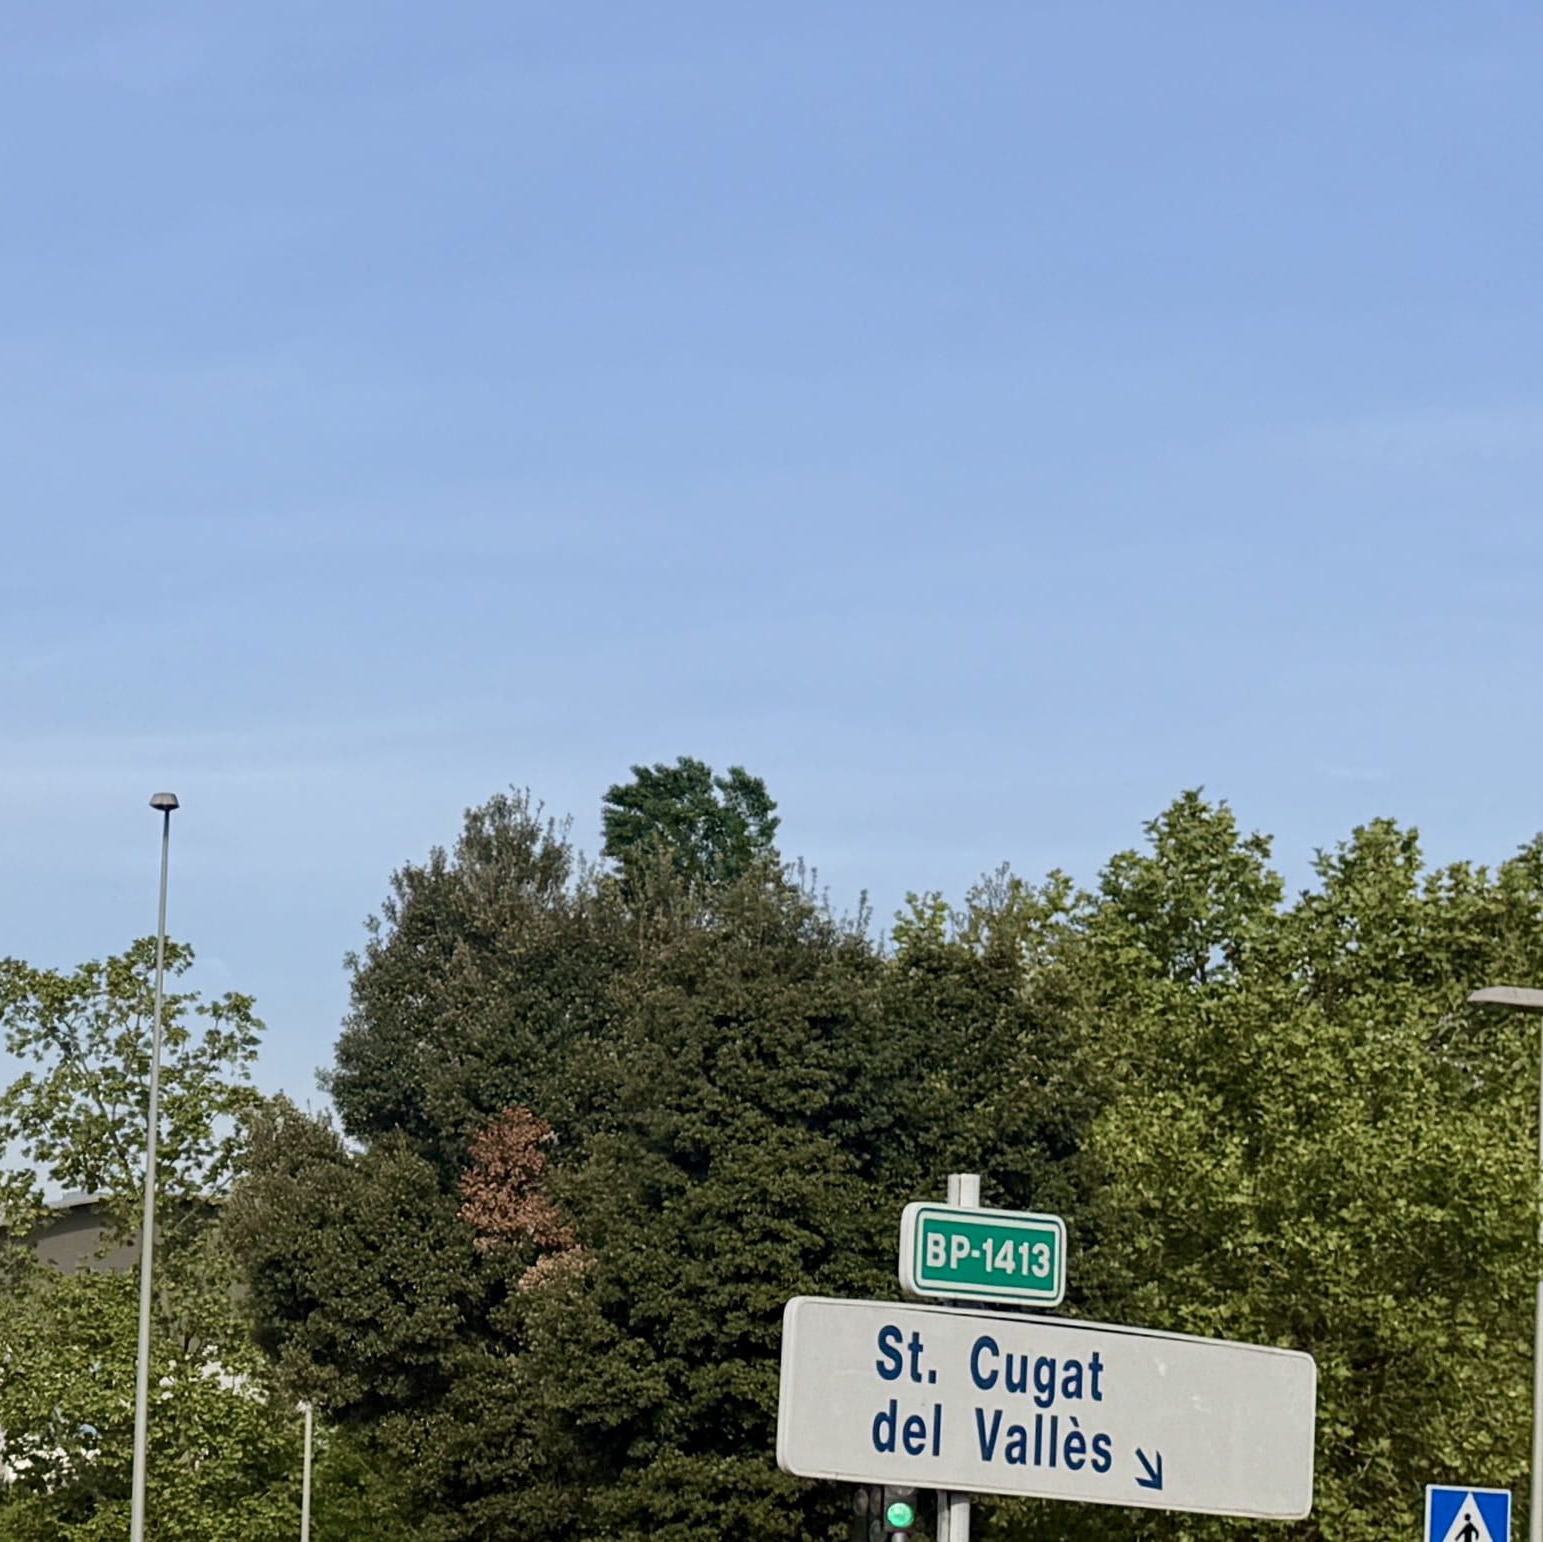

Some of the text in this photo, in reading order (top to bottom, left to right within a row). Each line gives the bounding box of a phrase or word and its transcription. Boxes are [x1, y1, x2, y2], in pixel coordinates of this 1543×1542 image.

[925, 1232, 1051, 1277] BP-1413
[875, 1325, 1104, 1408] St. Cugat
[872, 1399, 1113, 1473] del Vallès
